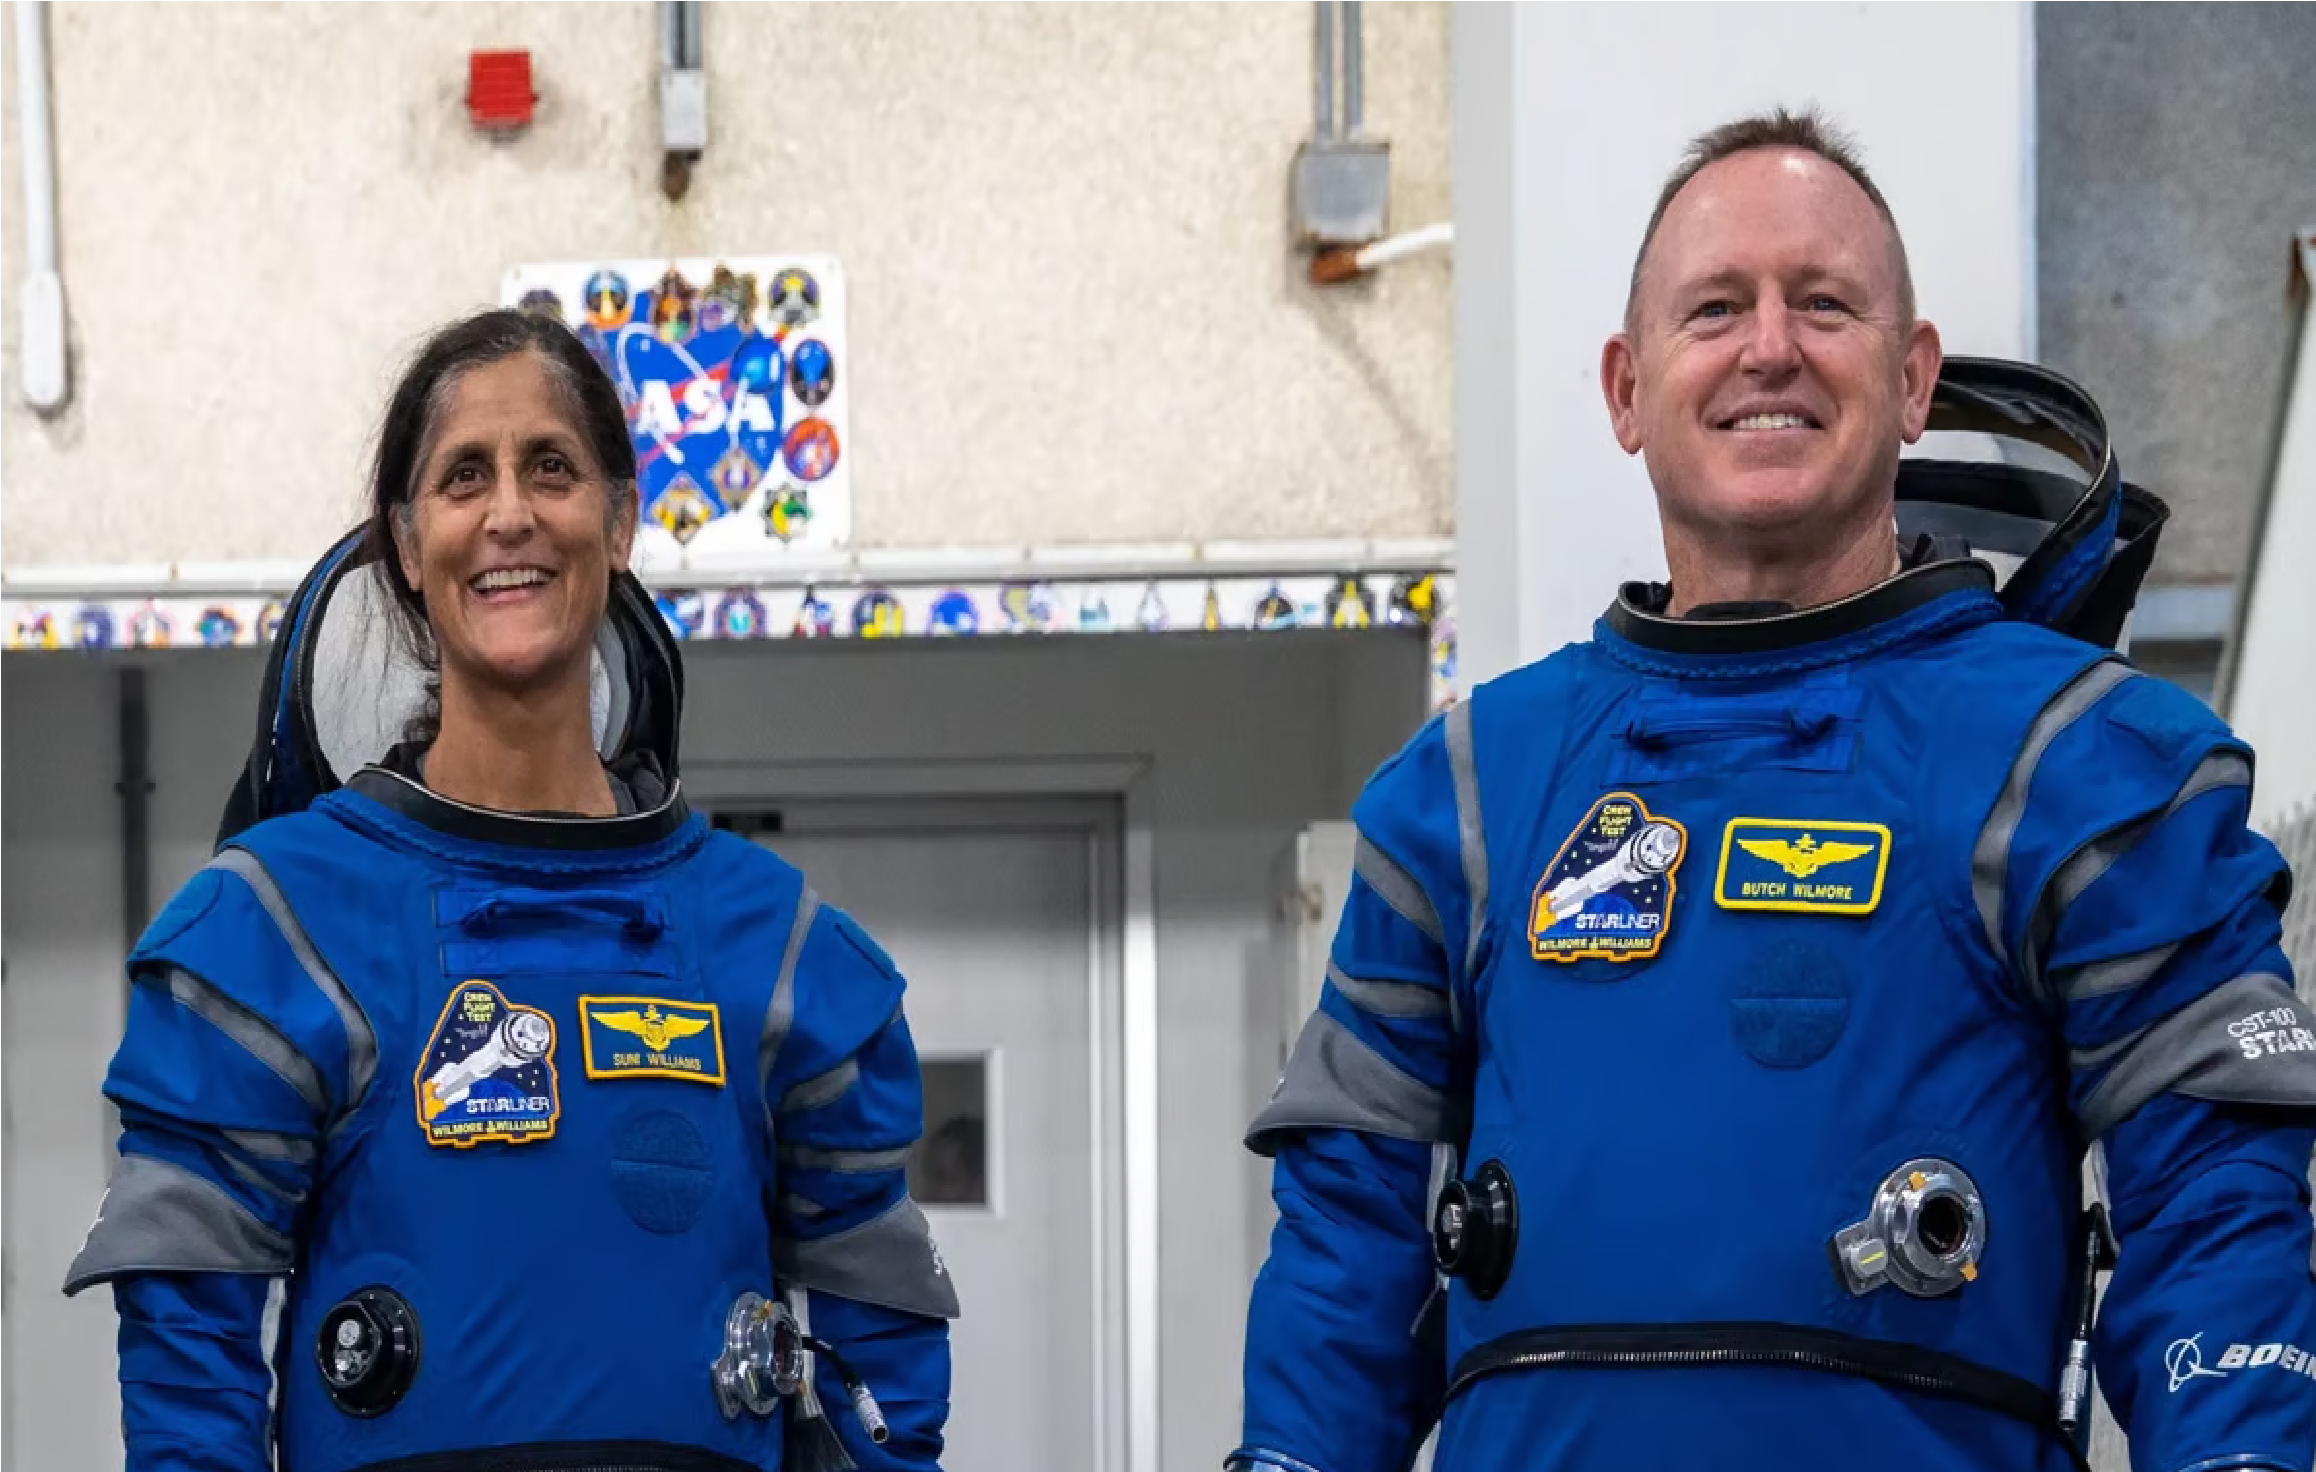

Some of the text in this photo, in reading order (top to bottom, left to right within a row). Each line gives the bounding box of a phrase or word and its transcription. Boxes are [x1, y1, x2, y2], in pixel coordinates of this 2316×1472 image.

[635, 379, 776, 432] ASA
[1742, 882, 1852, 899] BUTCH WILMORE
[1575, 913, 1660, 929] STARLINER
[2227, 1007, 2297, 1038] CST-100
[613, 1053, 702, 1070] SUNI WILLIAMS
[466, 1097, 550, 1114] STARLINER
